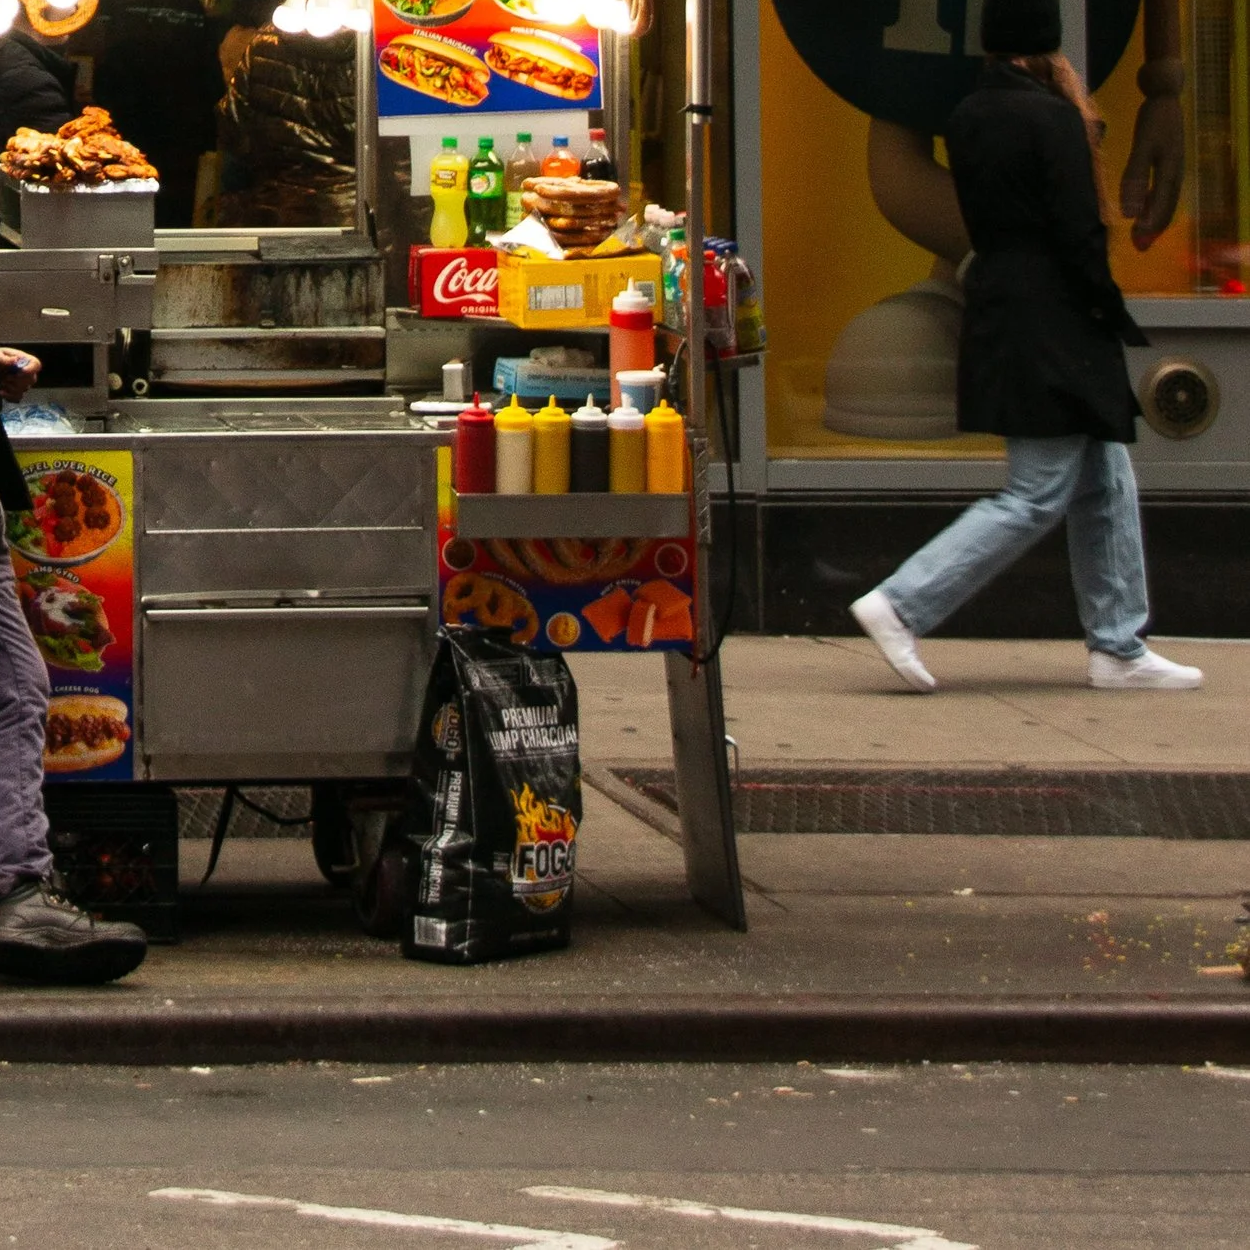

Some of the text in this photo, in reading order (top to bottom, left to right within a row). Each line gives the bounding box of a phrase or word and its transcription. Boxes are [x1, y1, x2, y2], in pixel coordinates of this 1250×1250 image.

[412, 27, 477, 57] ITALIAN SAUSAGE
[21, 460, 118, 488] AFEL OVER RICE
[55, 566, 80, 584] GYRO
[501, 704, 559, 729] PREMIUM
[446, 770, 463, 821] PREMIUM
[427, 848, 444, 904] CHARCOAL
